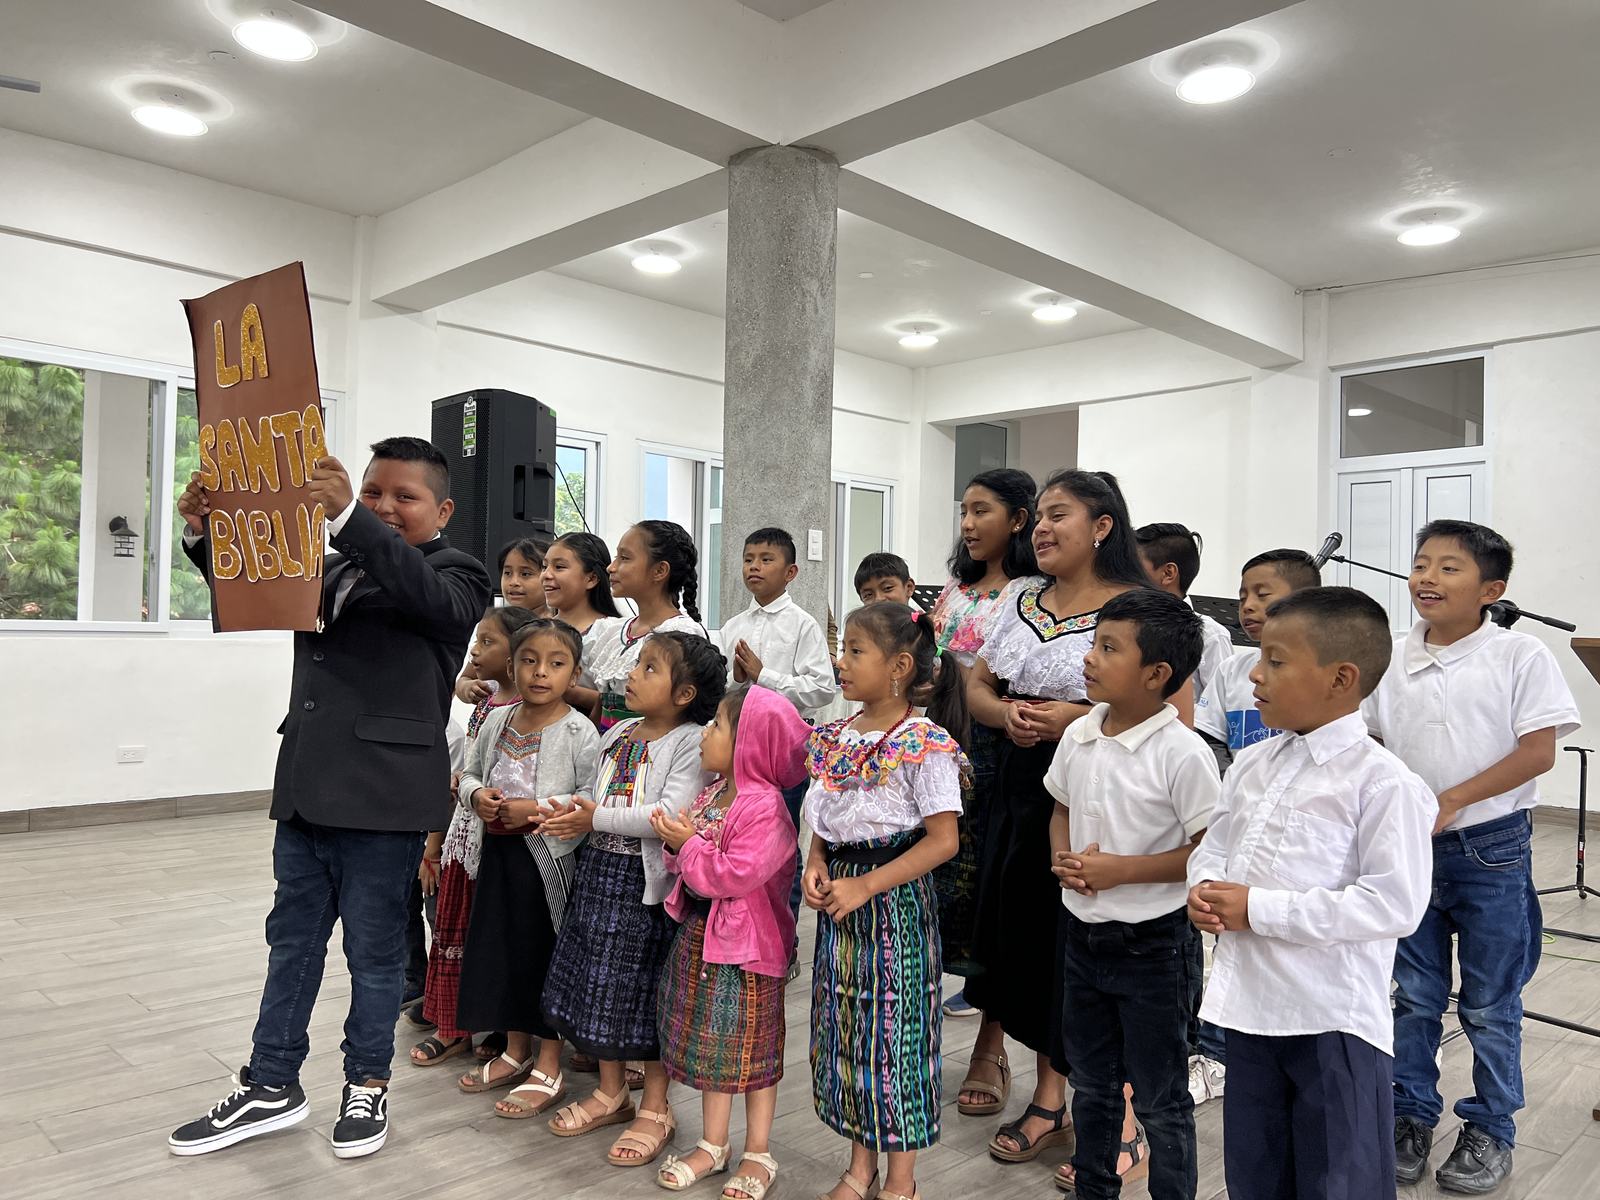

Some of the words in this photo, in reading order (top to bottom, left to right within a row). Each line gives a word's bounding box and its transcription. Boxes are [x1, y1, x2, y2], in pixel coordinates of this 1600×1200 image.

[213, 303, 269, 388] LA
[199, 404, 326, 493] SANTA
[210, 503, 325, 582] BIBLIA
